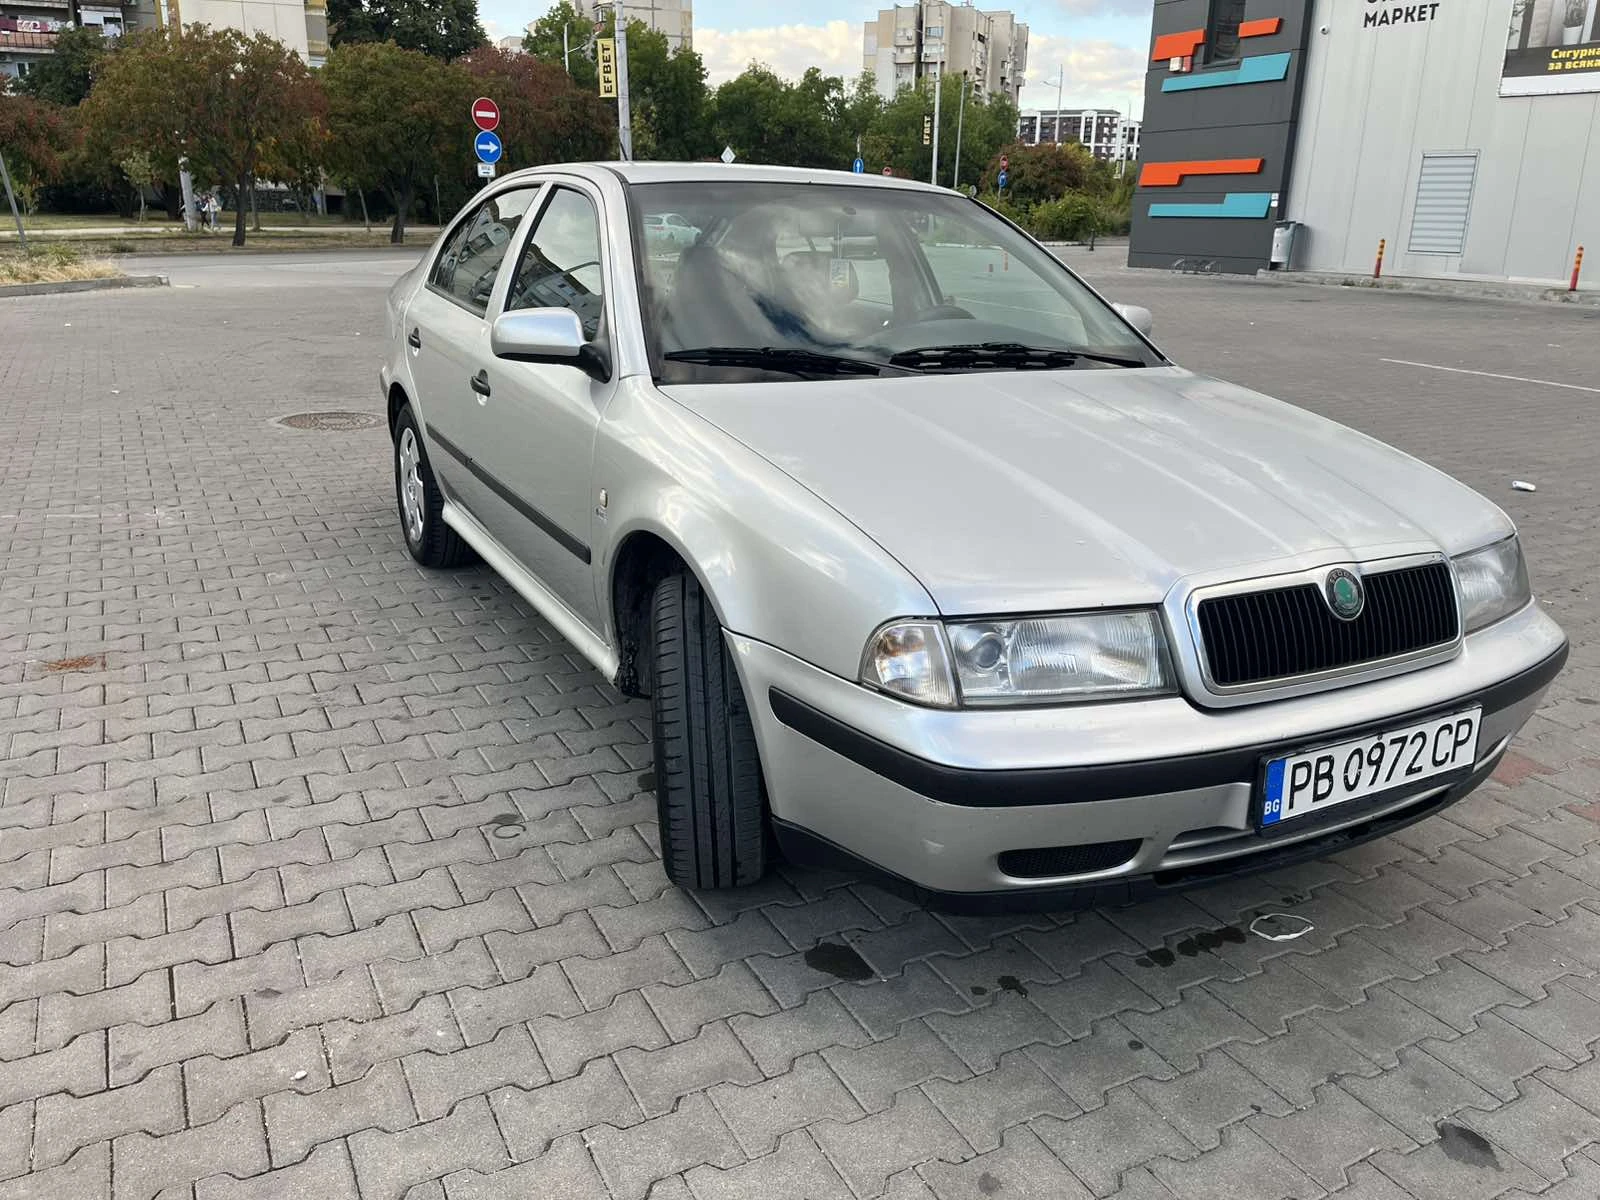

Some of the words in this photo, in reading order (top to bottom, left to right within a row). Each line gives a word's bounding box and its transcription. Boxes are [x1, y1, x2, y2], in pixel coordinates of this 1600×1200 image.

[1363, 3, 1440, 28] МАРКЕТ
[601, 43, 612, 94] EFBET
[1547, 62, 1562, 71] за
[1264, 798, 1280, 815] BG
